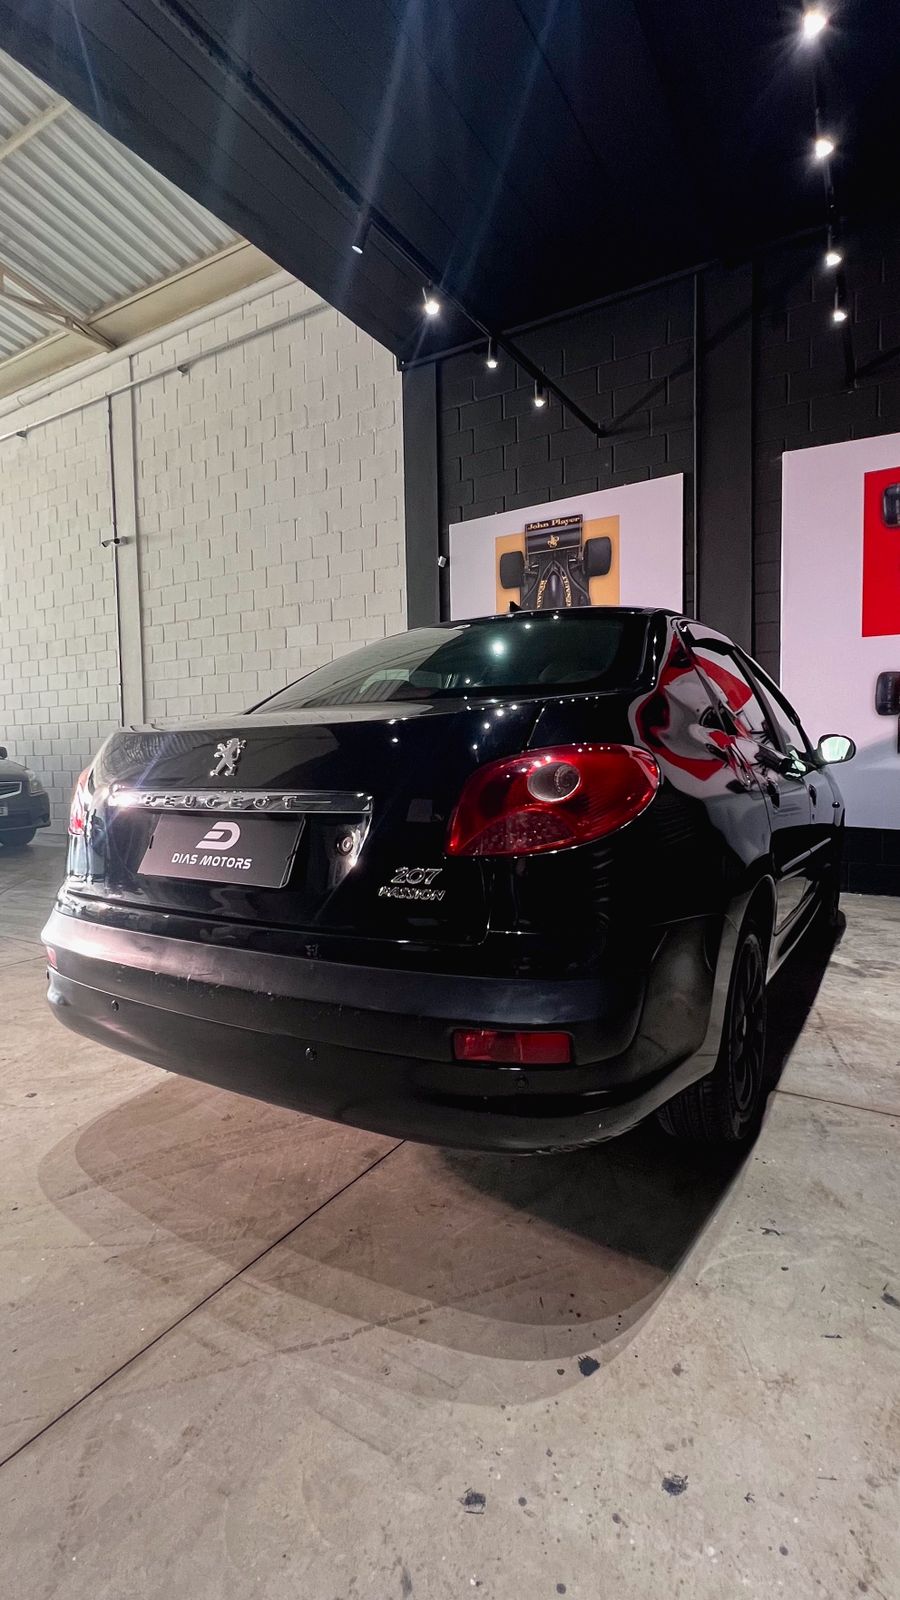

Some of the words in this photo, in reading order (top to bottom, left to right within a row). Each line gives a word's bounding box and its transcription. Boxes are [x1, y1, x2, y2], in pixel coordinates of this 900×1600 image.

[551, 517, 580, 526] Player
[142, 795, 298, 809] PEUGEOT
[171, 853, 198, 865] DIAS
[199, 855, 252, 870] MOTORS
[391, 867, 443, 884] 207
[378, 886, 446, 901] PASSION
